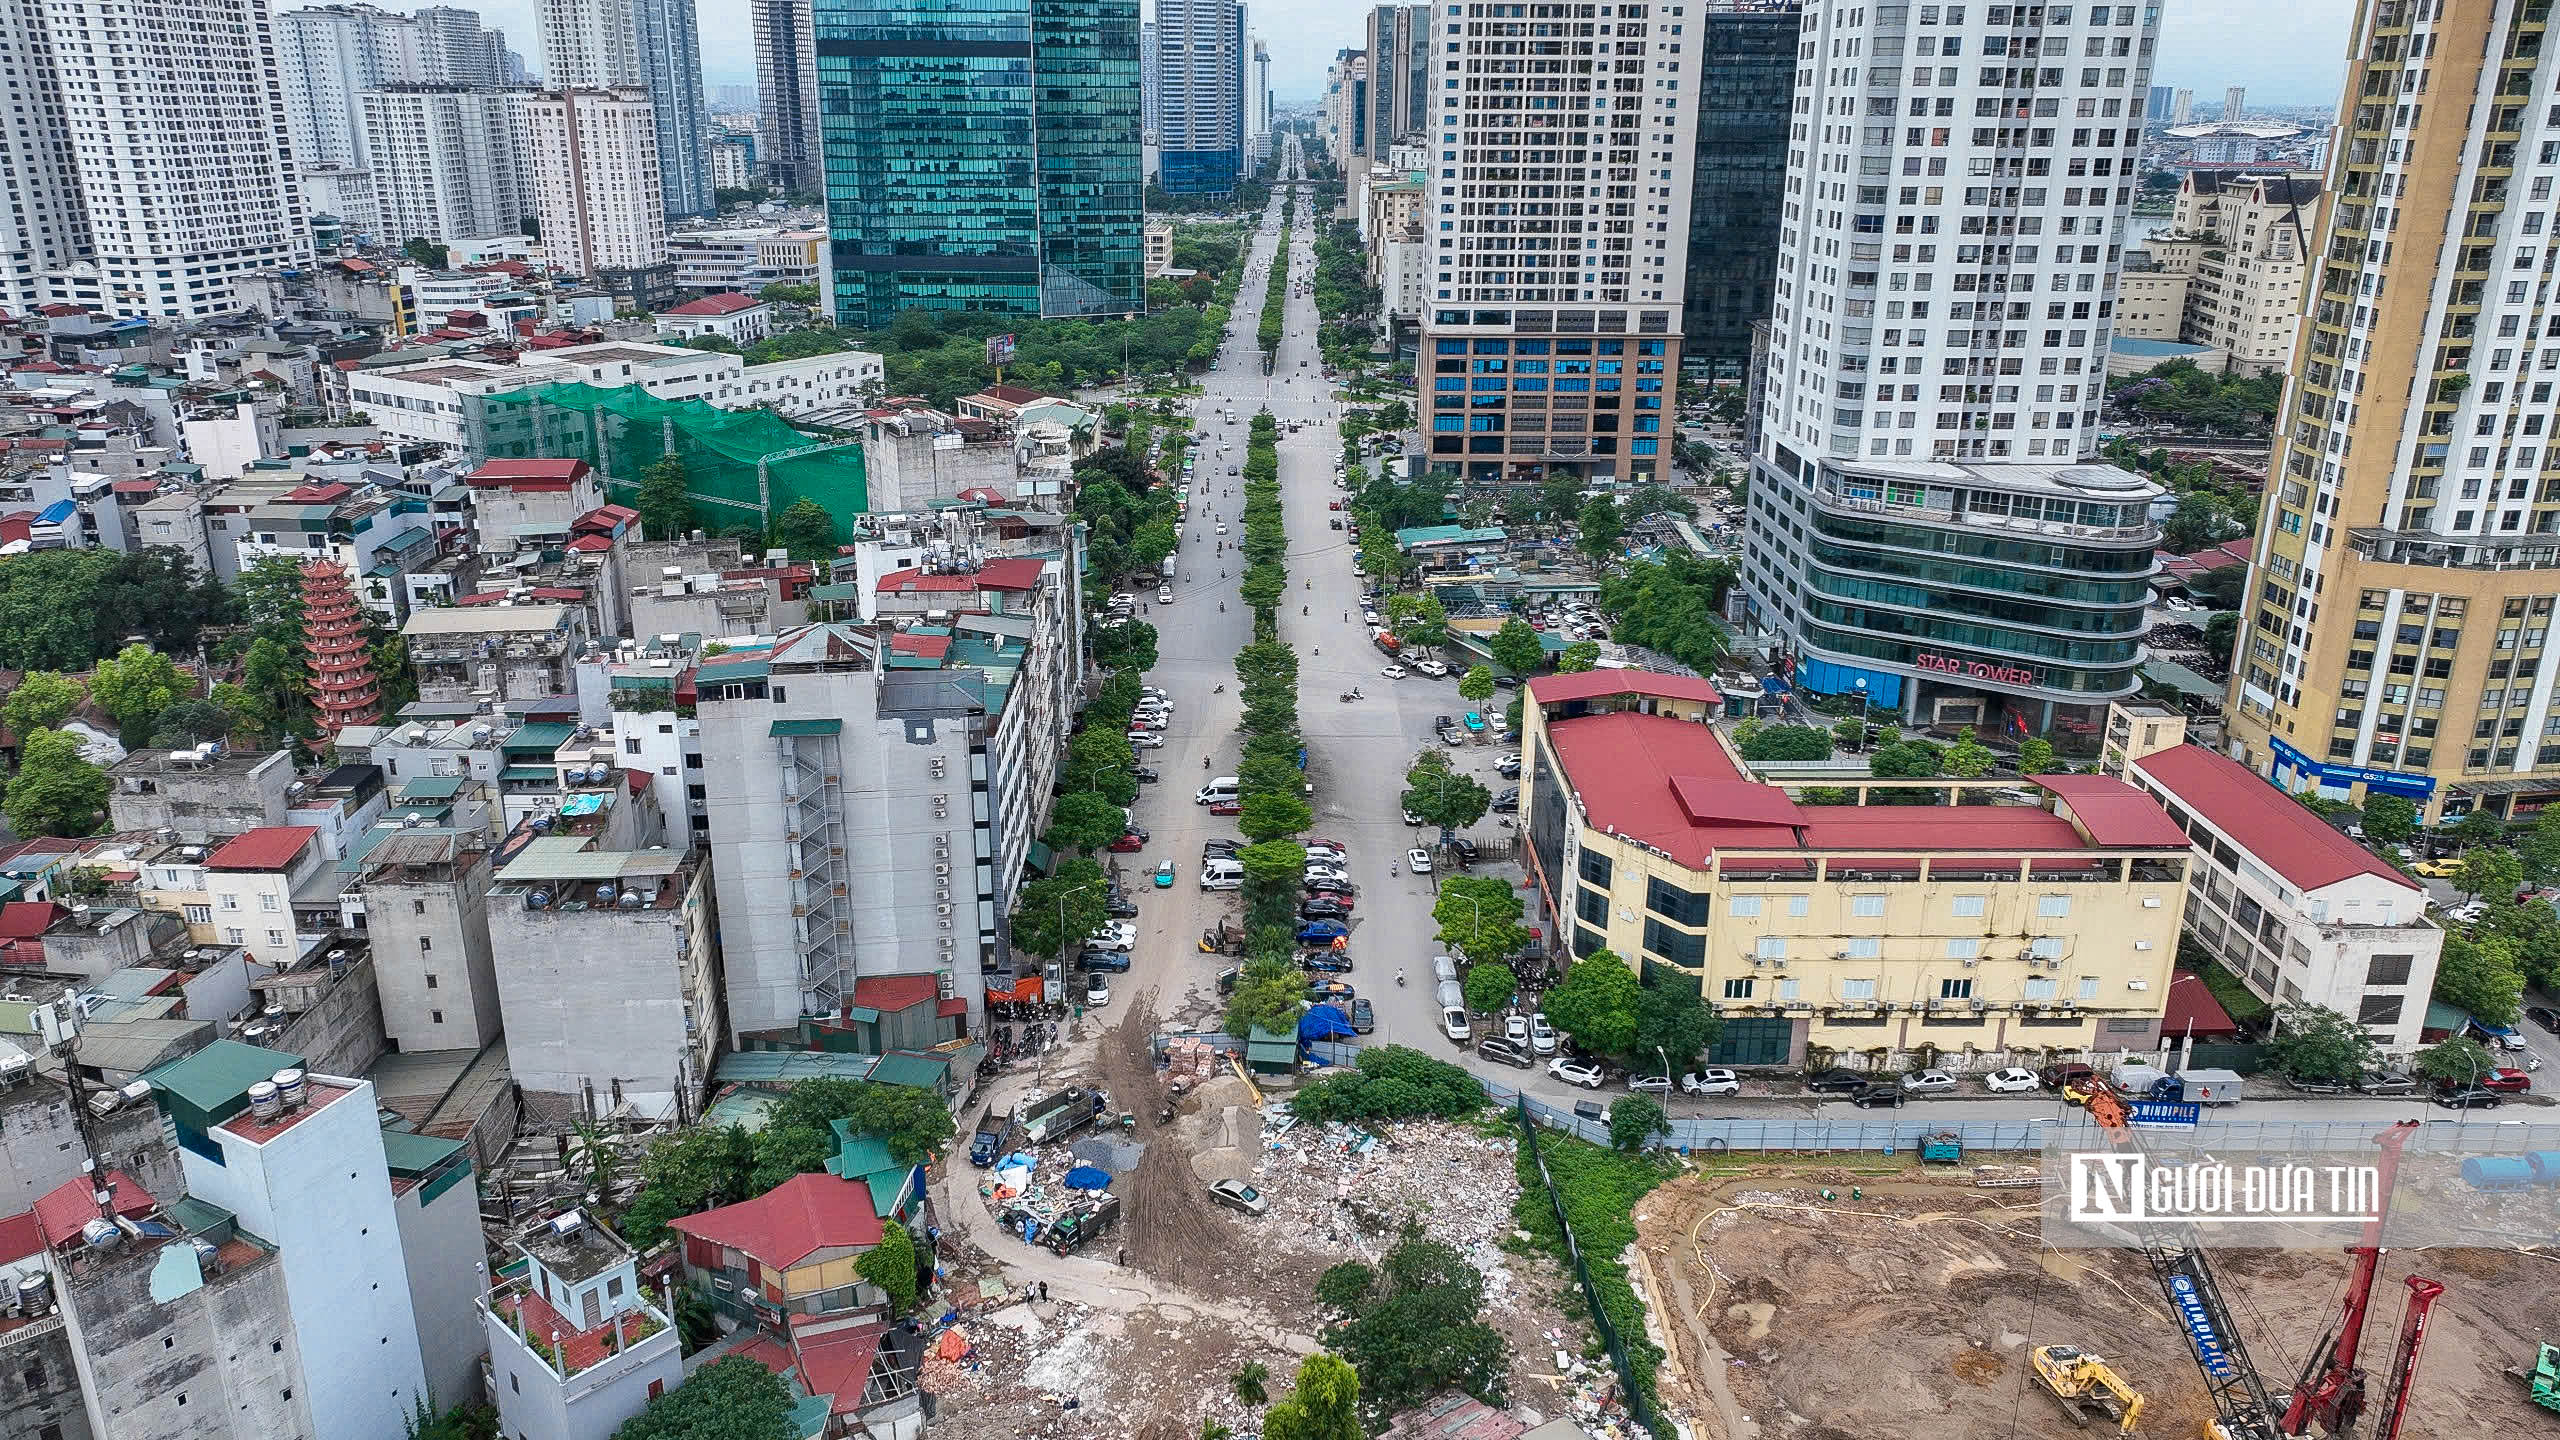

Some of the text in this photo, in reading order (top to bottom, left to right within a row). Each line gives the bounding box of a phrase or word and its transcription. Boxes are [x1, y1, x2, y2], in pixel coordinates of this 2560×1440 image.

[1917, 653, 2032, 686] STAR TOWER
[2362, 772, 2385, 782] GS25
[2141, 1104, 2196, 1118] MINDIPILE
[2182, 1293, 2230, 1374] MINDIPILE
